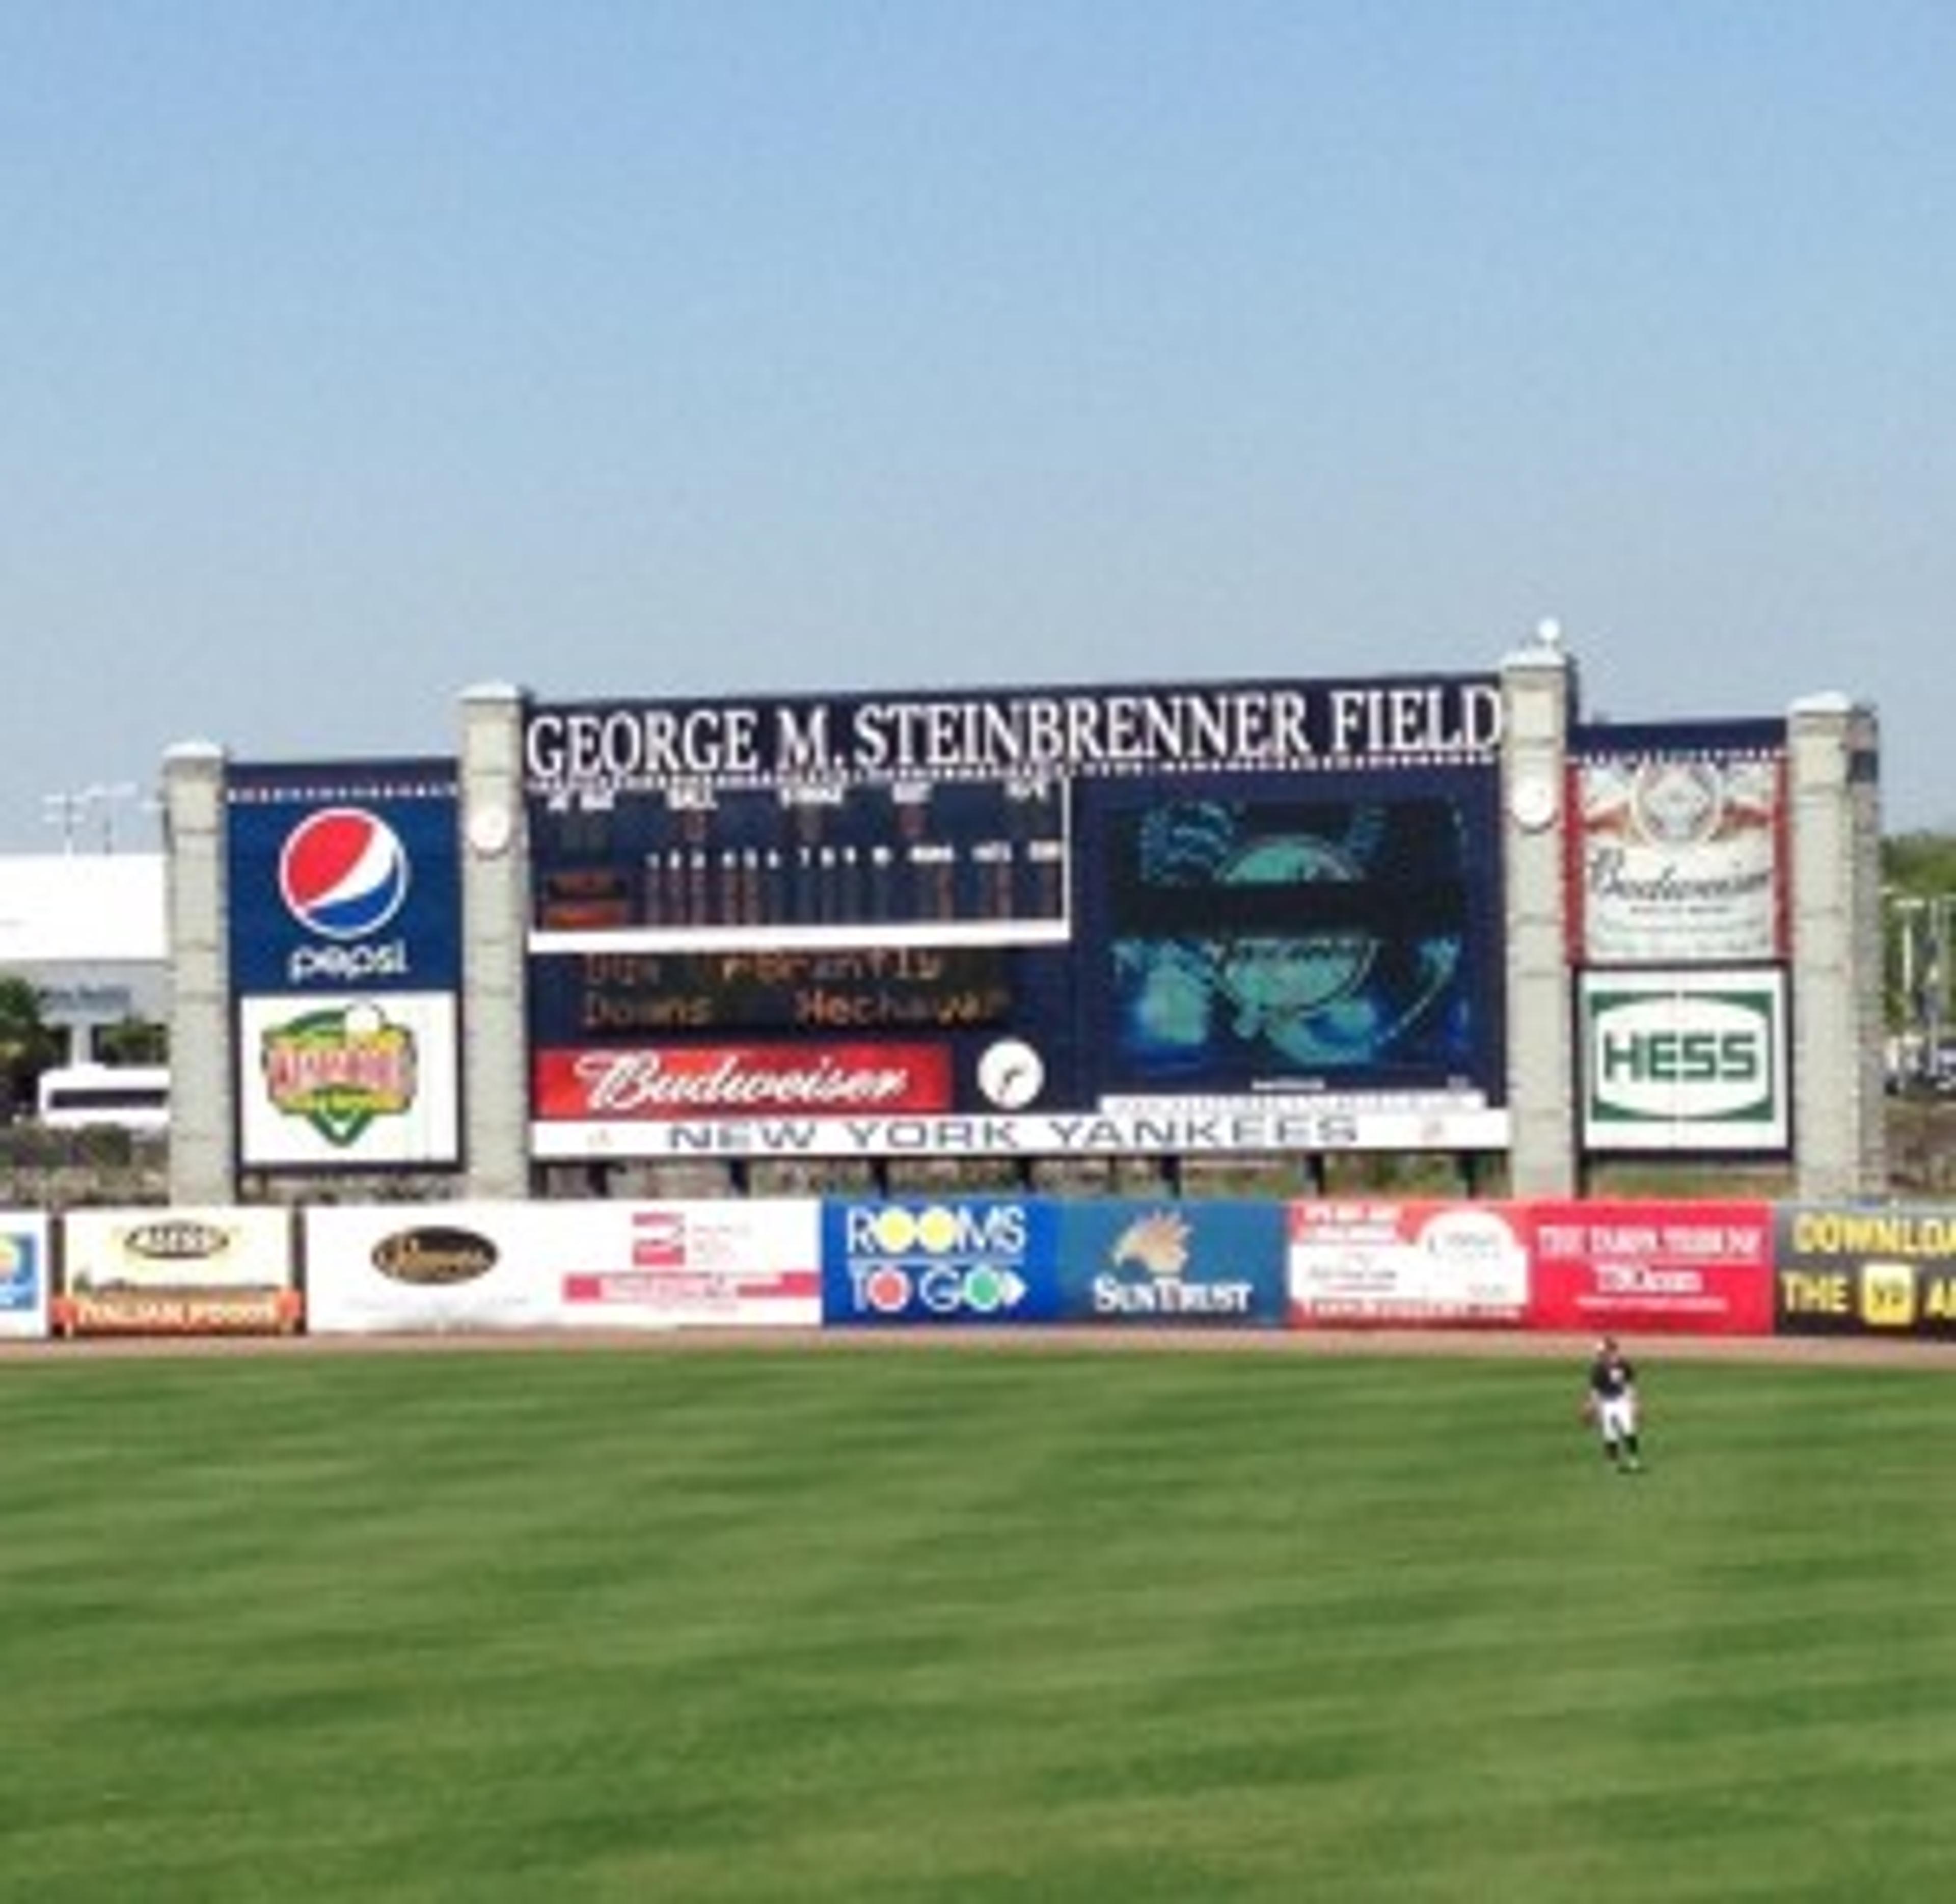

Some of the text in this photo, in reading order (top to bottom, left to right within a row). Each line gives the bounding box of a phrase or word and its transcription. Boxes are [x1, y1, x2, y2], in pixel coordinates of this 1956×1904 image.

[527, 685, 1500, 778] GEORGE M. STEINBRENNER FIELD
[1589, 847, 1773, 901] Budweiser
[290, 940, 408, 983] pepsi
[574, 1049, 908, 1110] Budweiser
[1602, 1032, 1757, 1081] HESS
[668, 1116, 1358, 1149] NEW YORK YANKEES
[847, 1205, 1026, 1254] ROOMS
[850, 1263, 910, 1313] TO
[919, 1263, 1000, 1313] GO
[1781, 1272, 1848, 1313] THE
